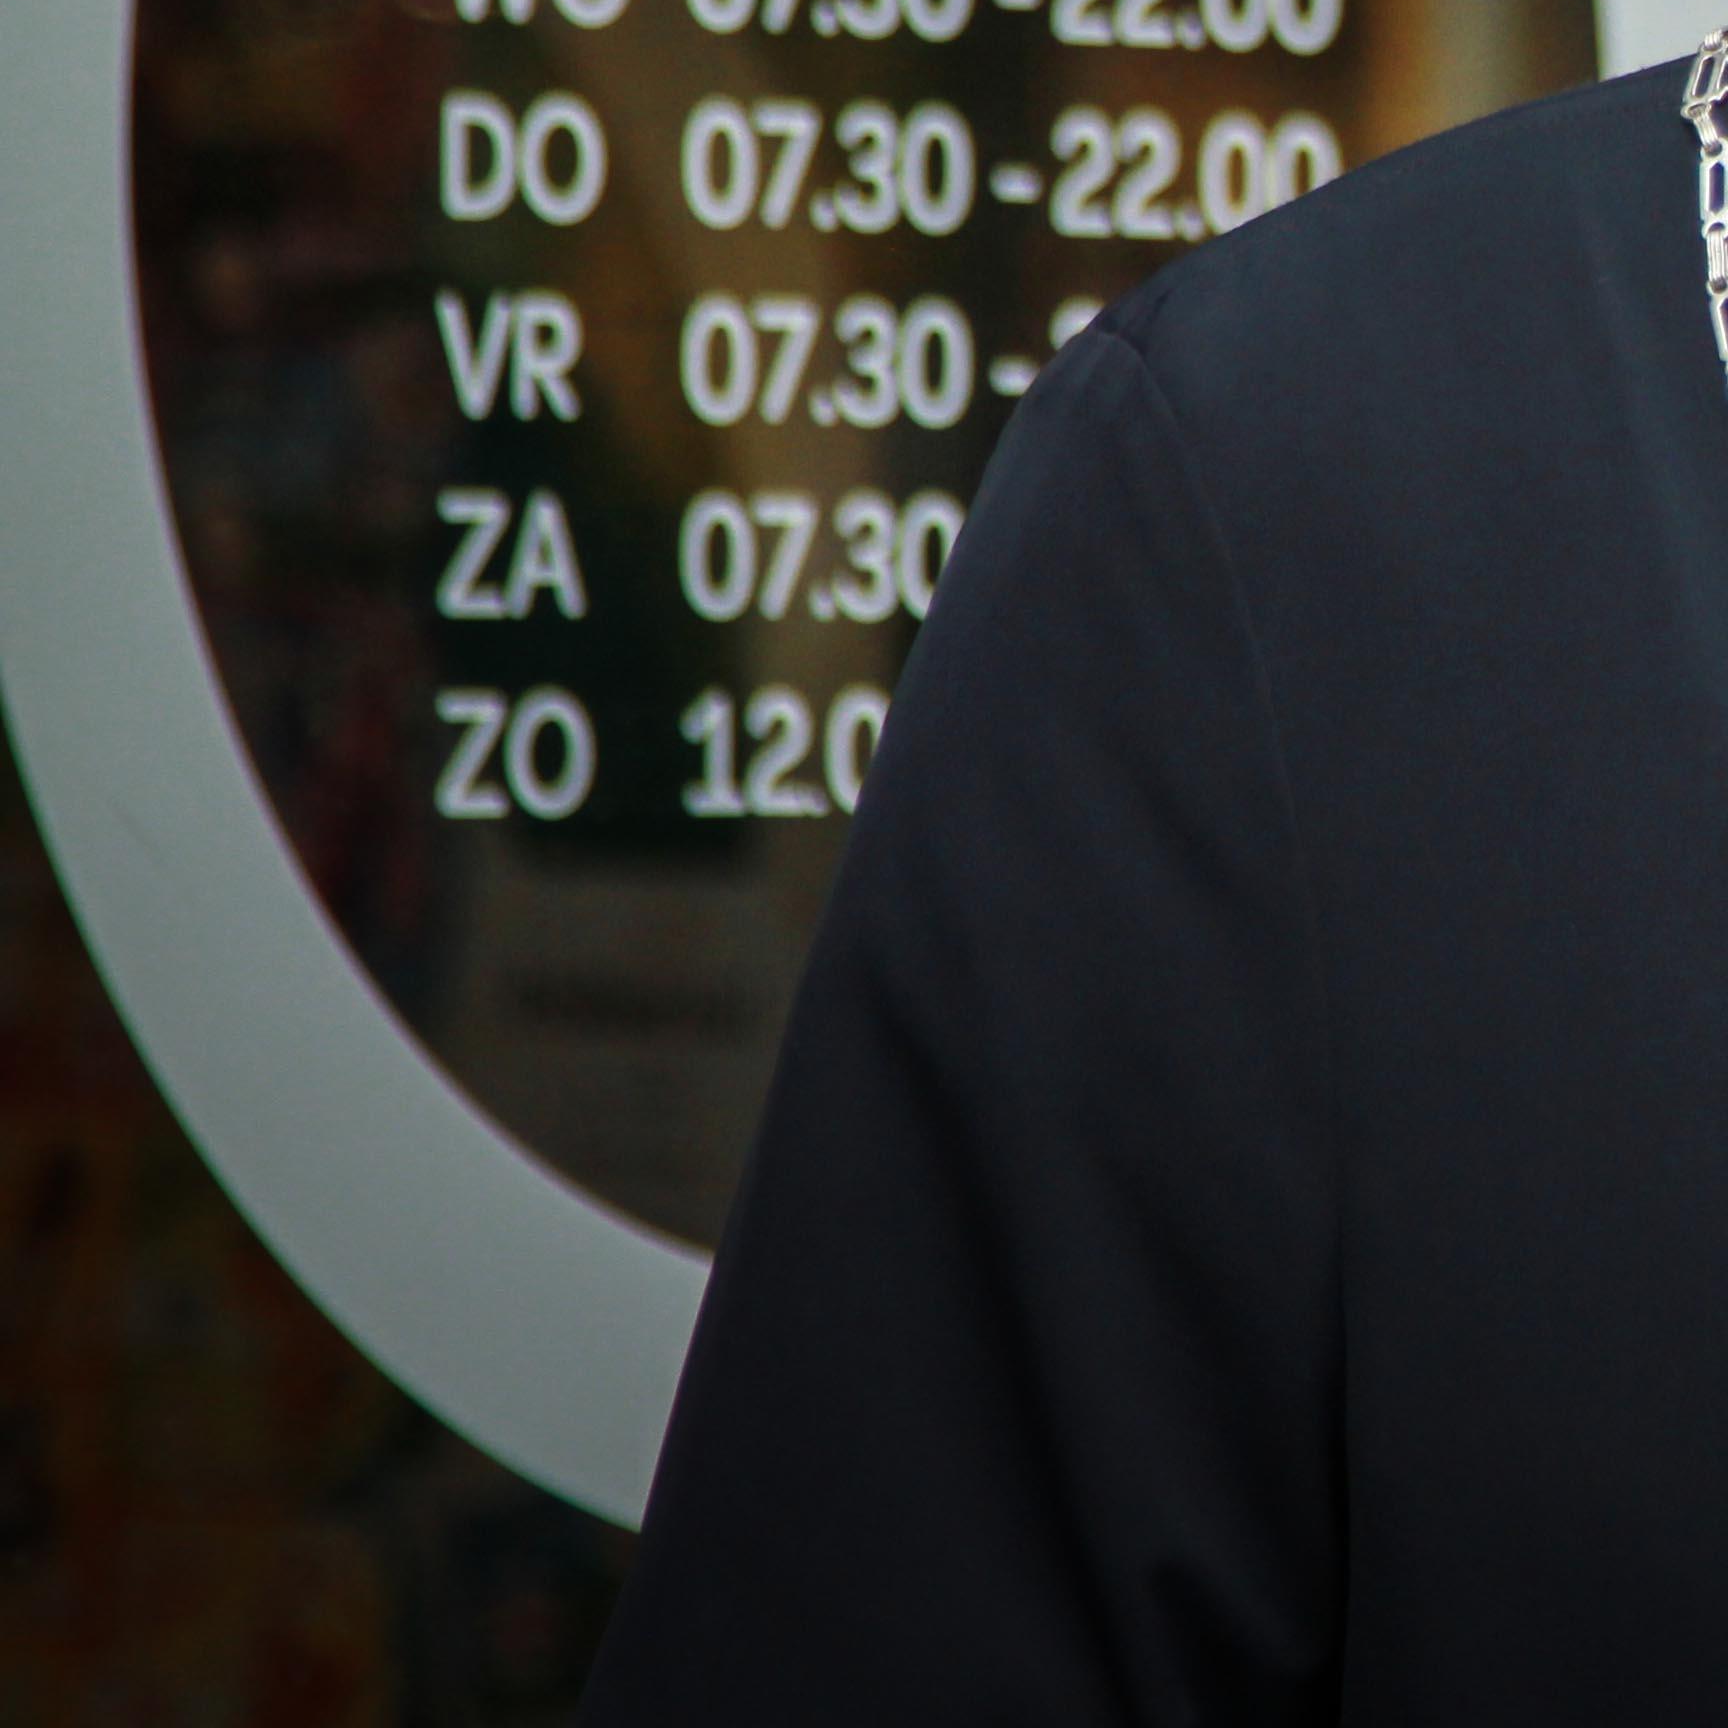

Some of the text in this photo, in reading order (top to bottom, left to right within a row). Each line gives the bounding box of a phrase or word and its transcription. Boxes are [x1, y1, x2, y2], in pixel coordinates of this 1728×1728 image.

[440, 88, 608, 226] DO
[437, 288, 584, 423] VR
[436, 488, 590, 621] ZA
[436, 684, 598, 823] ZO
